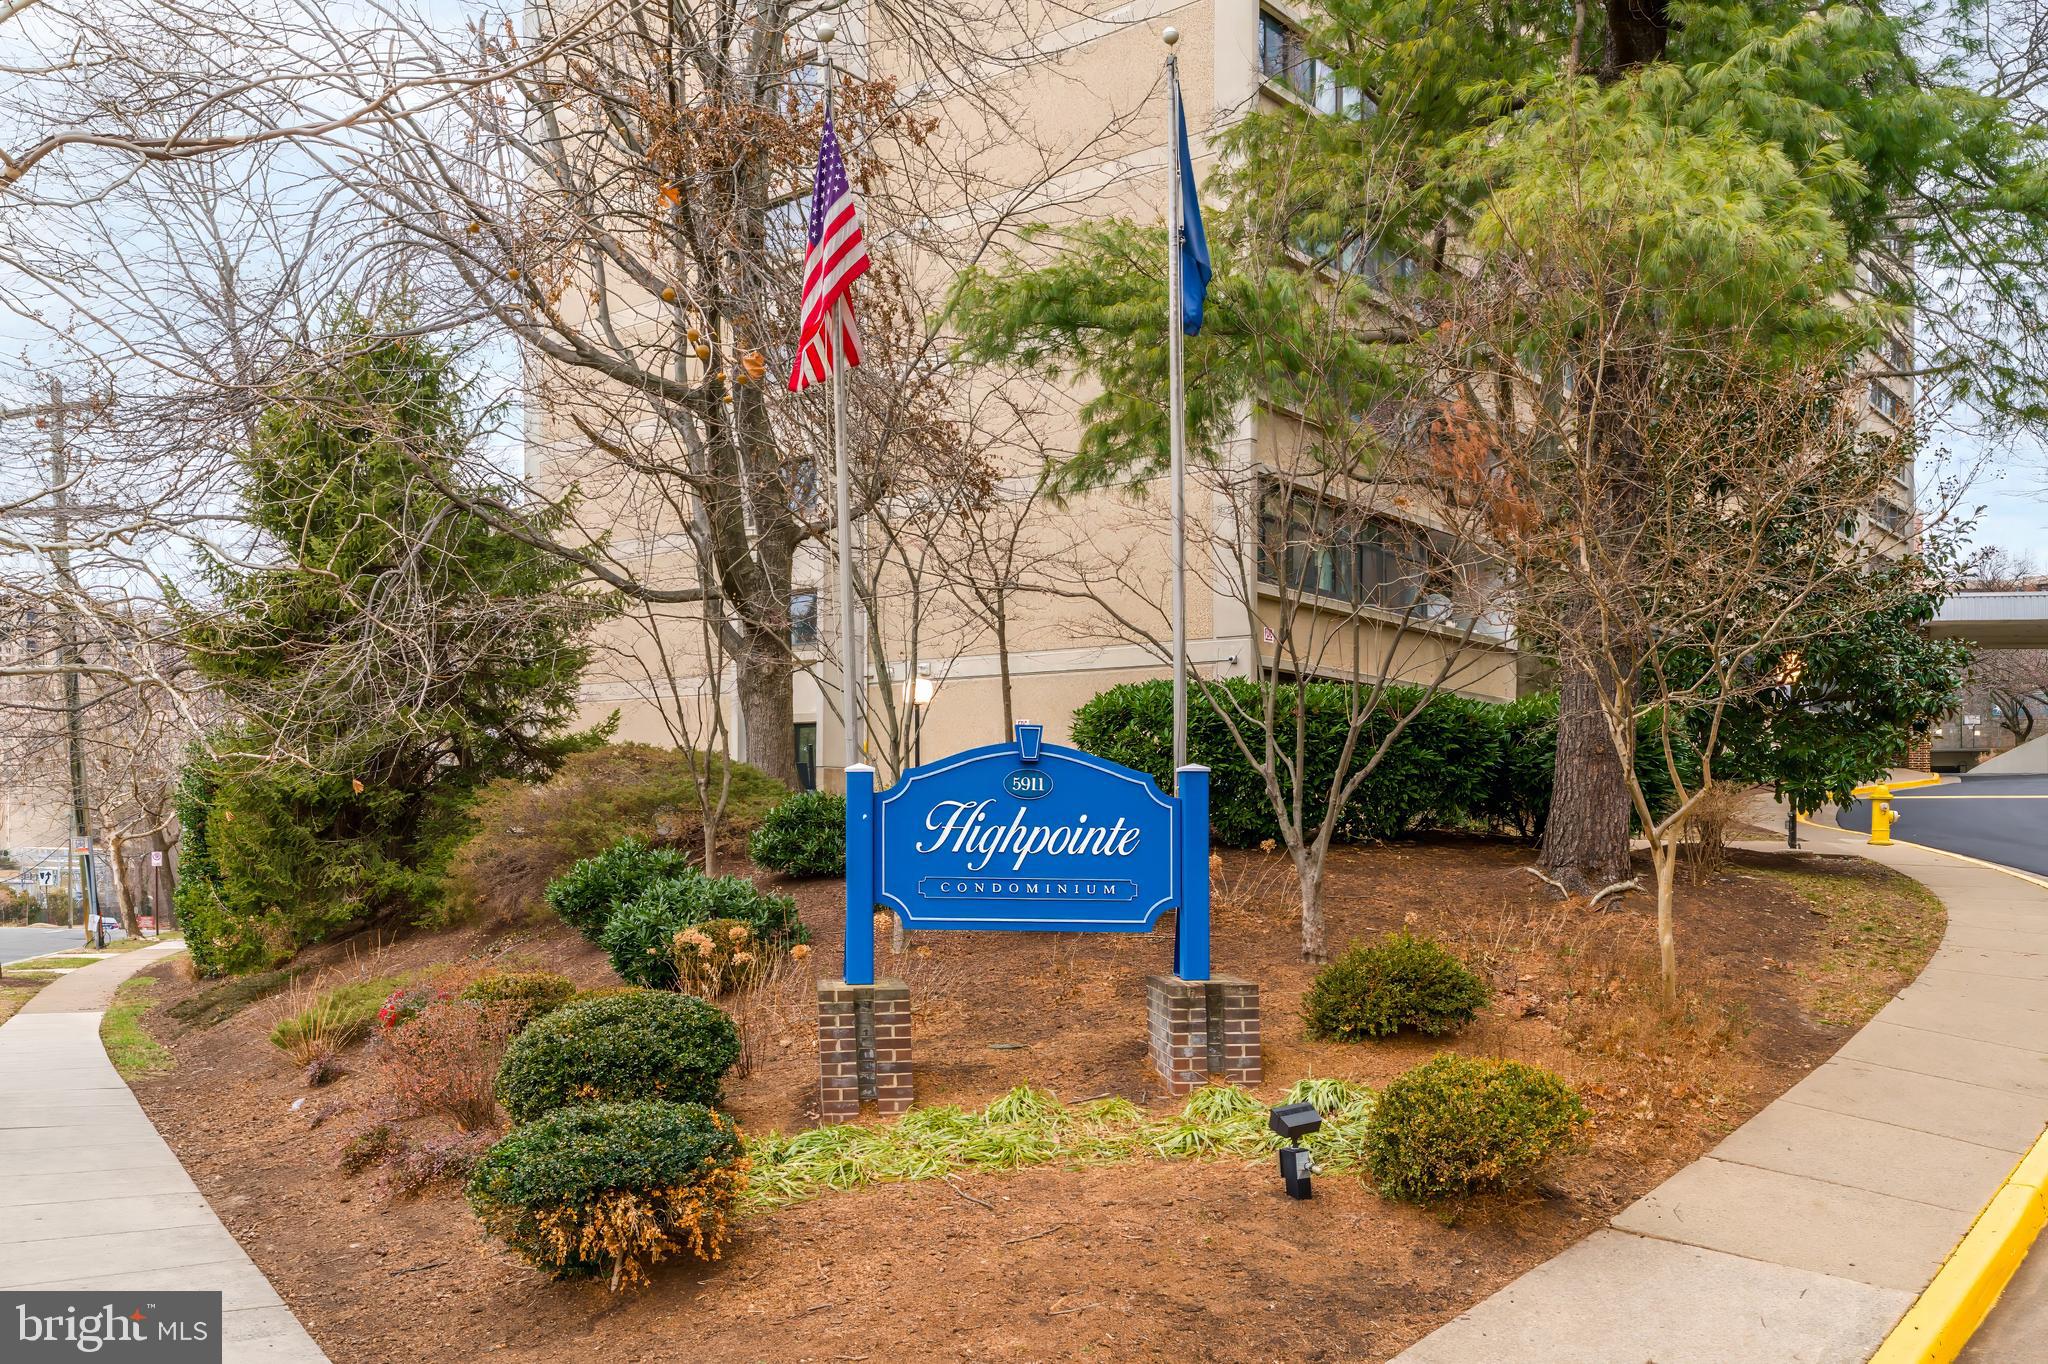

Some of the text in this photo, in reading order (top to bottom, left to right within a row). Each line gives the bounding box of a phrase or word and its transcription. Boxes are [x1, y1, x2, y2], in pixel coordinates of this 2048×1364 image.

[1011, 776, 1045, 792] 5911
[915, 798, 1141, 871] Highpointe
[940, 881, 1117, 895] CONDOMINIUM
